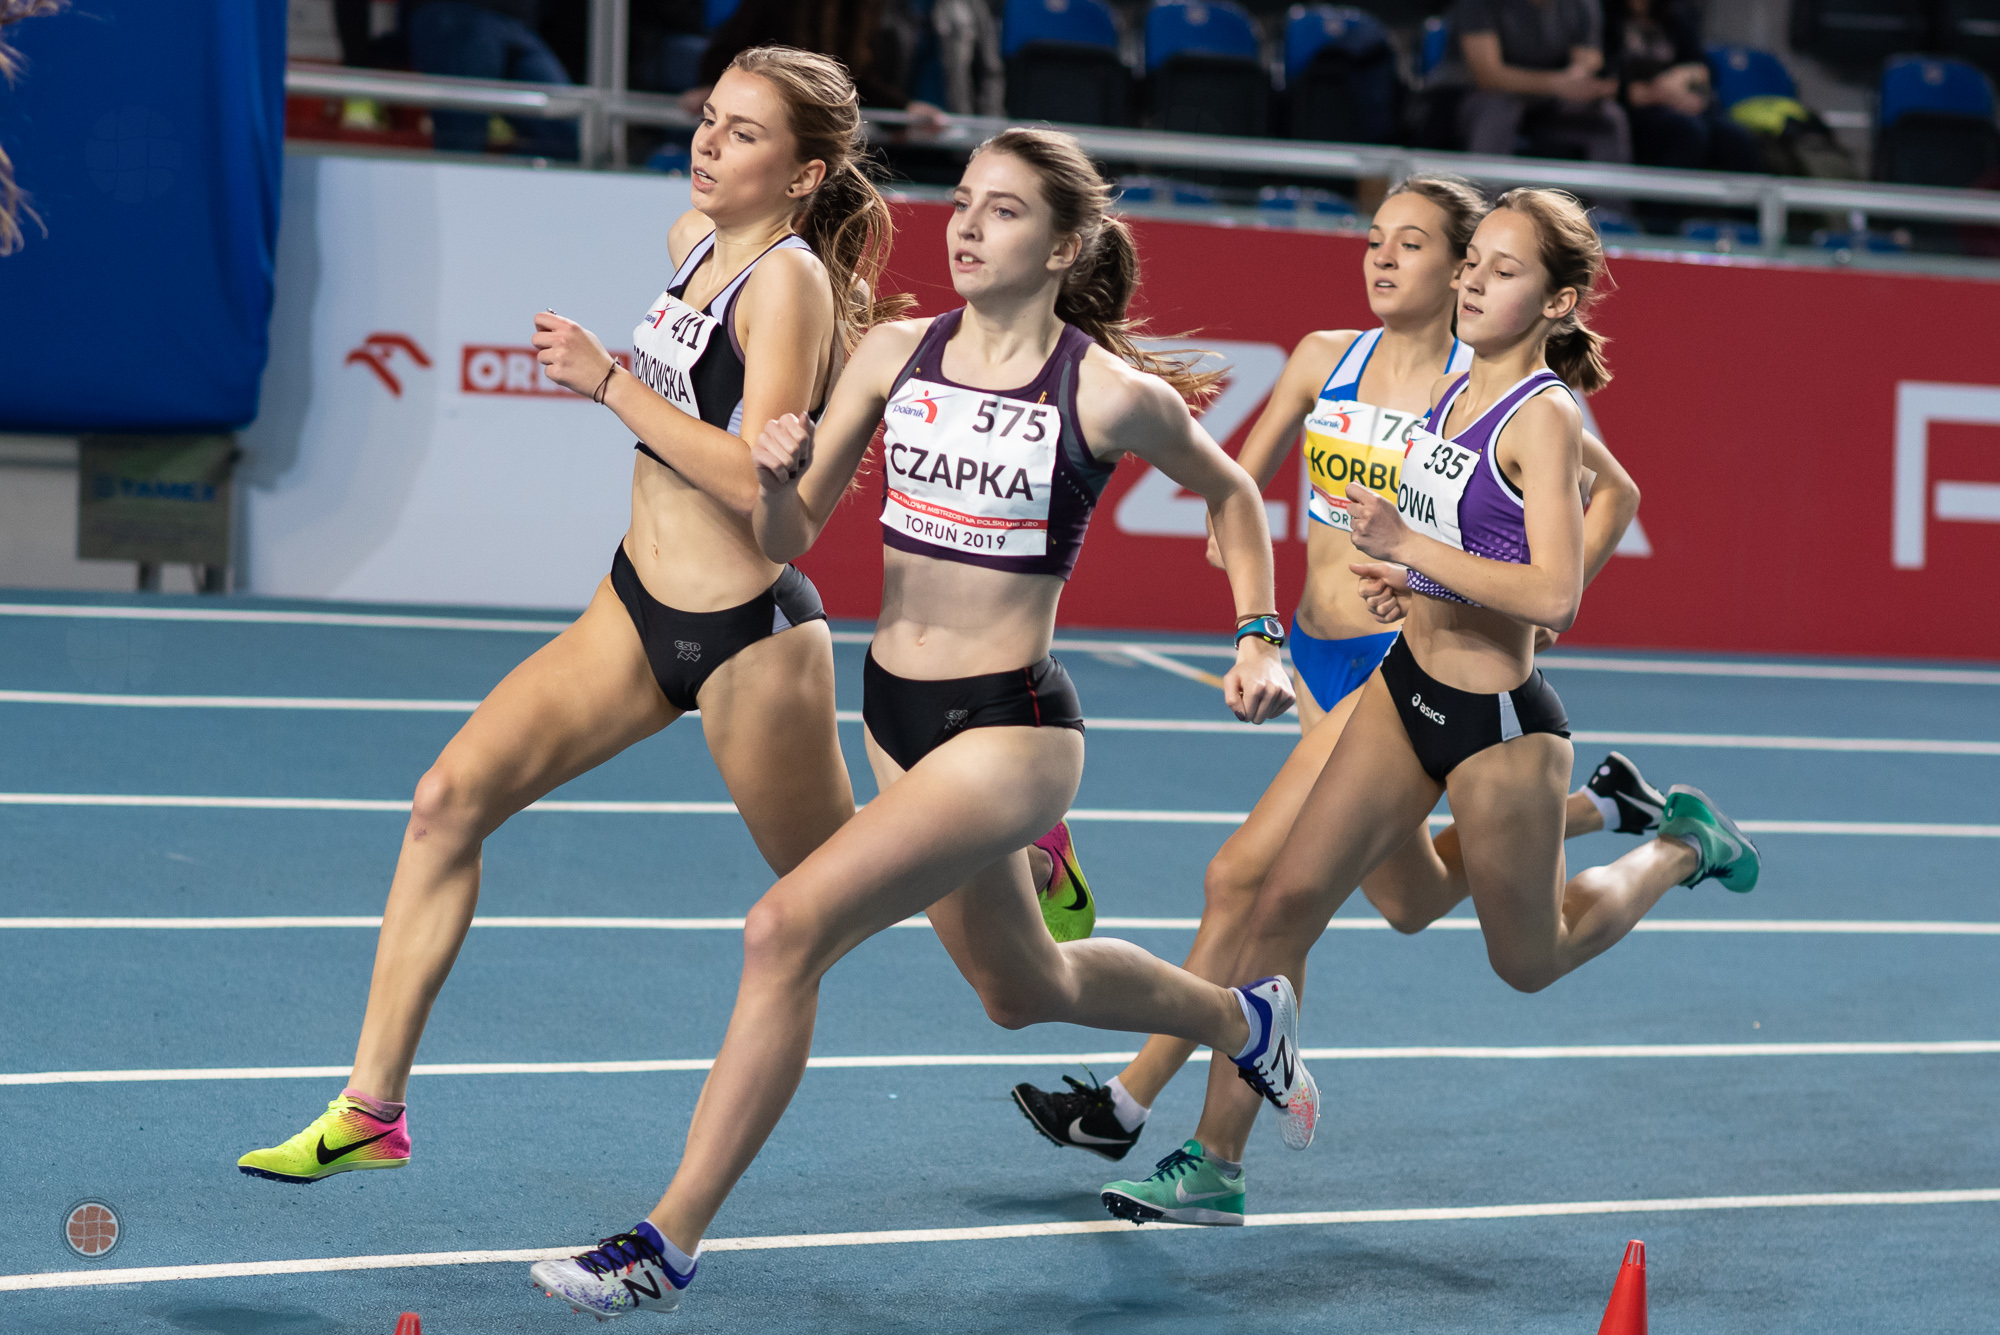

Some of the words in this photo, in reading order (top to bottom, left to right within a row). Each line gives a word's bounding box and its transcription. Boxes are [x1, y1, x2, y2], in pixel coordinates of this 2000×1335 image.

[671, 312, 706, 351] 411
[892, 404, 926, 419] polanik
[972, 399, 1048, 442] 575
[890, 442, 1035, 502] CZAPKA
[1424, 443, 1470, 480] 535
[905, 513, 958, 543] TORUŃ
[963, 531, 1006, 549] 2019
[927, 505, 976, 525] MISTRZOSTWA
[976, 519, 1005, 527] POLSKI
